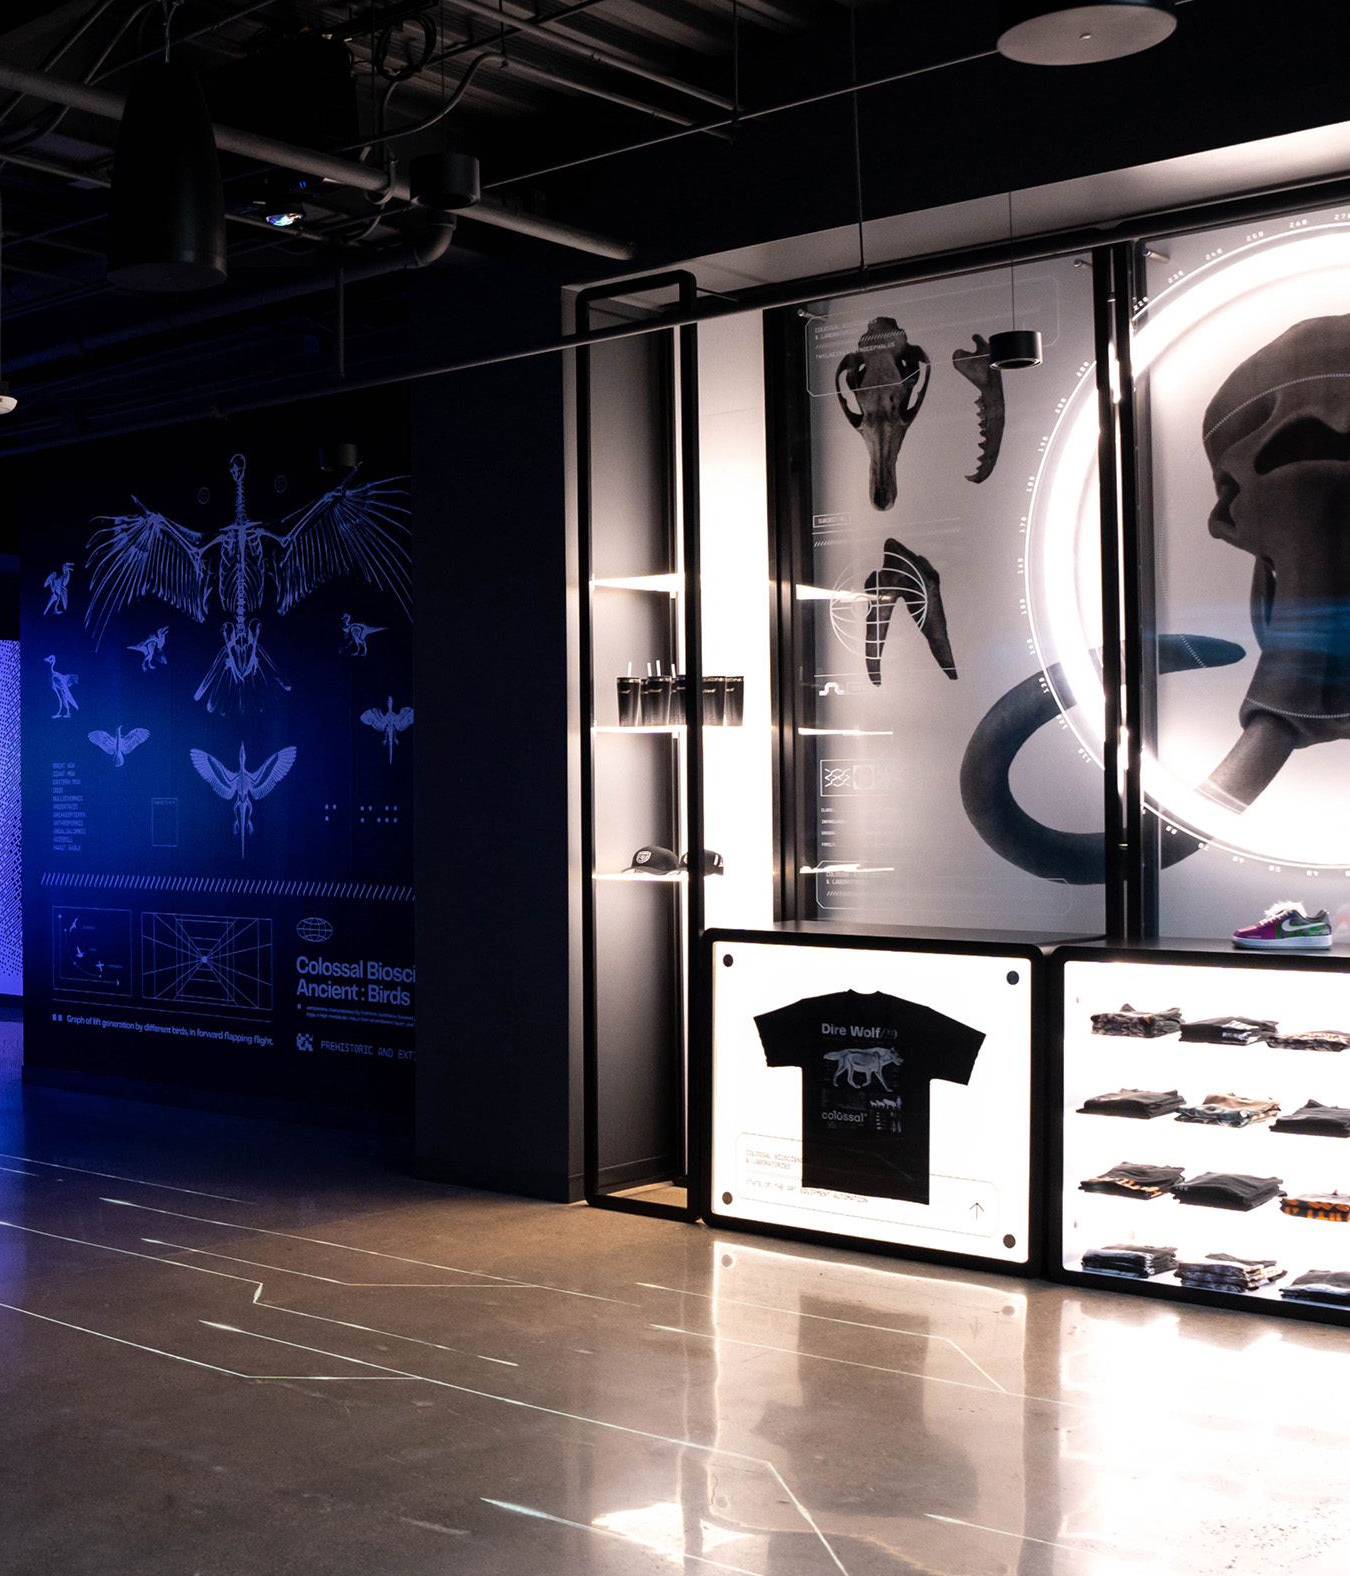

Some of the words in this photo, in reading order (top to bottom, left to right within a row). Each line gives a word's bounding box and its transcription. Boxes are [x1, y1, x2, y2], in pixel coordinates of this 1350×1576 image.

[296, 955, 364, 979] Colossal
[296, 978, 359, 1001] Ancient
[368, 984, 411, 1006] Birds
[66, 1014, 85, 1025] Graph
[101, 1020, 135, 1030] generation
[135, 1022, 144, 1033] by
[196, 1028, 224, 1040] forward
[224, 1031, 253, 1045] flapping
[821, 1022, 847, 1036] Dire
[321, 1040, 374, 1055] PREHISTORIC
[378, 1047, 394, 1058] AND
